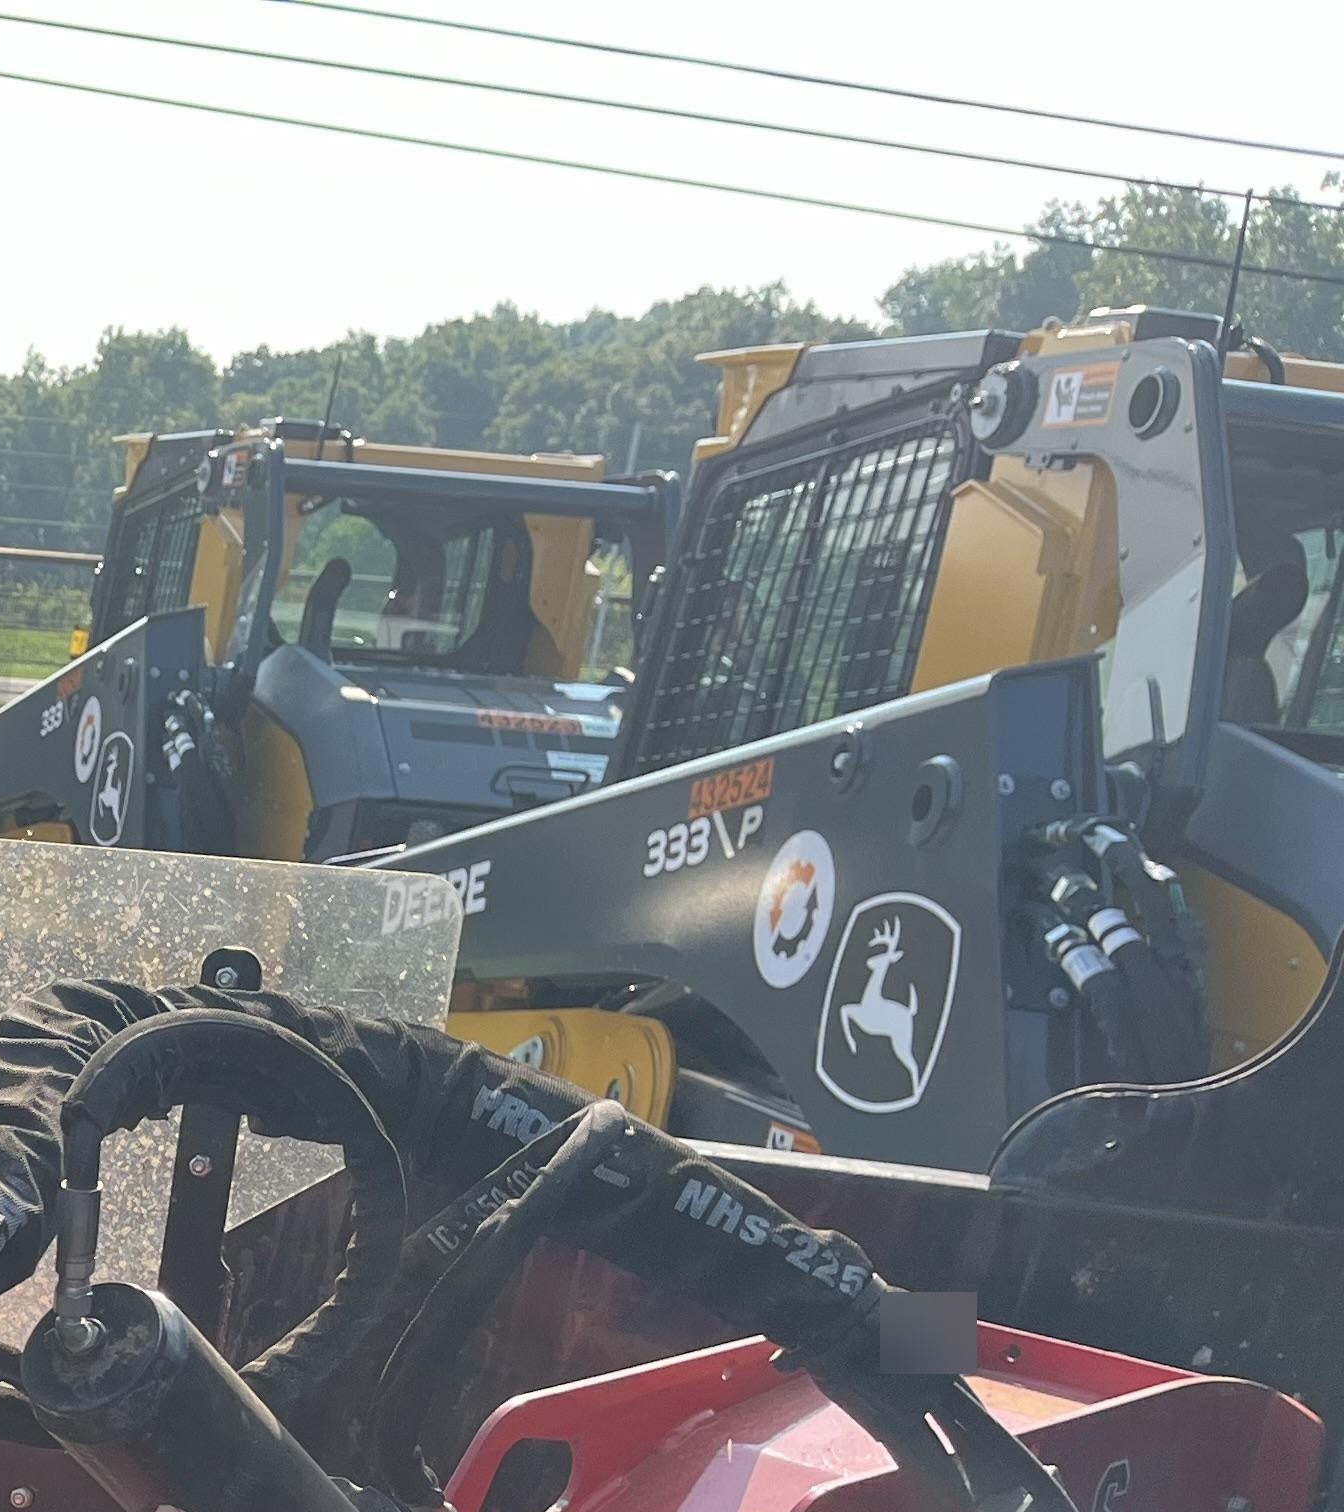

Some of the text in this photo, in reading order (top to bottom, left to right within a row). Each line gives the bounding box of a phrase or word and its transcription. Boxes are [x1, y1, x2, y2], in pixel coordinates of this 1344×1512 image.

[381, 860, 491, 937] DEERE
[470, 1084, 558, 1146] PRO
[674, 1178, 869, 1297] NHS-225
